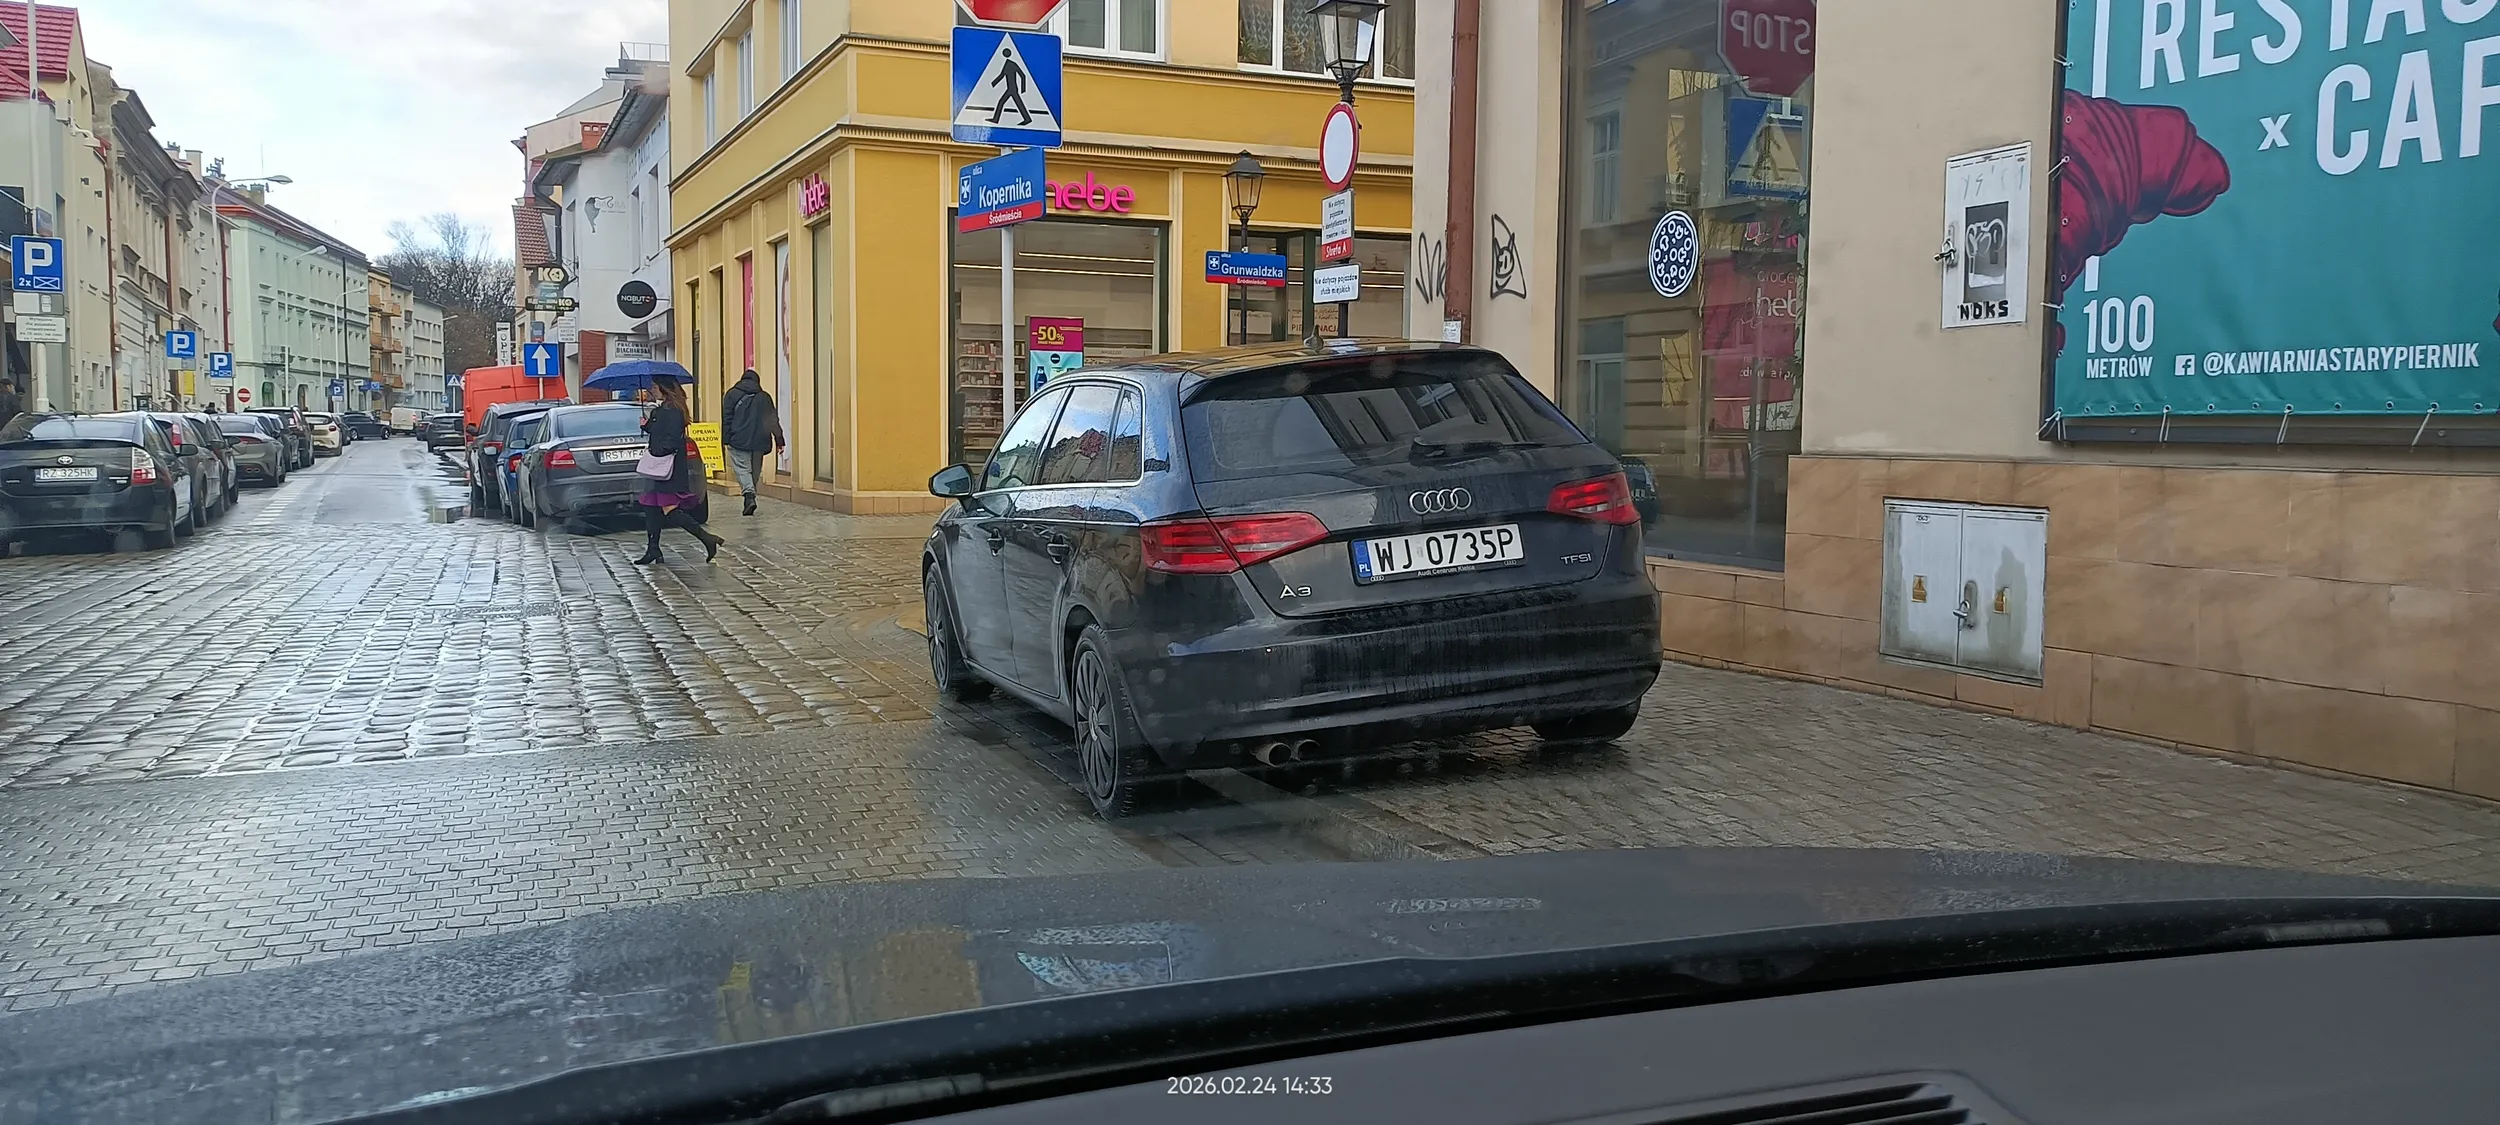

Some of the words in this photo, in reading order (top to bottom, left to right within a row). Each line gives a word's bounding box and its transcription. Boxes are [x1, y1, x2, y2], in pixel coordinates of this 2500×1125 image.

[2140, 0, 2500, 89] RES
[803, 173, 826, 216] hebe
[979, 177, 1032, 211] Kopernika
[988, 208, 1022, 225] Śródmieście
[24, 241, 53, 275] P
[1325, 244, 1341, 258] Strefa
[1342, 241, 1347, 254] A
[1221, 263, 1283, 278] Grunwaldzka
[18, 277, 32, 287] 2x
[2082, 295, 2155, 354] 100
[1032, 326, 1064, 342] -50%
[172, 333, 190, 354] P
[214, 354, 228, 370] P
[2086, 354, 2154, 379] METRÓW
[2203, 342, 2479, 376] @KAWIARNIASTARYPIERNIK
[606, 450, 624, 459] RST
[42, 470, 56, 478] RZ
[62, 468, 93, 477] 325HK
[1374, 539, 1412, 572] WJ
[1425, 528, 1514, 566] 0735P
[1560, 552, 1592, 565] TFSI
[1358, 564, 1370, 572] PL
[1432, 568, 1457, 576] Centrum
[1280, 584, 1312, 599] A3
